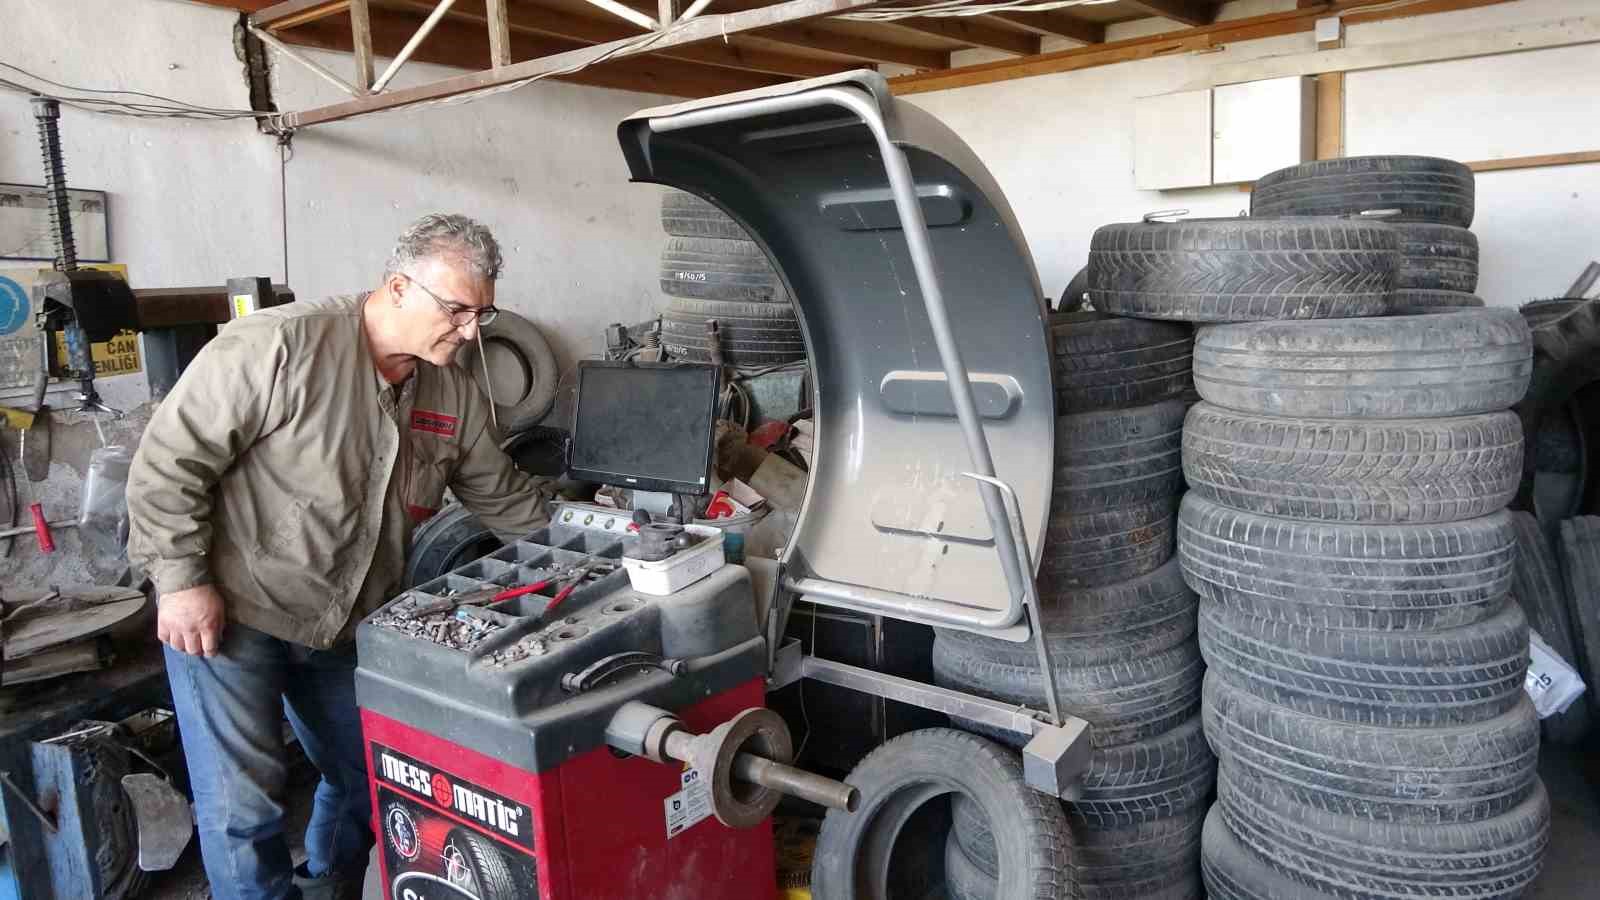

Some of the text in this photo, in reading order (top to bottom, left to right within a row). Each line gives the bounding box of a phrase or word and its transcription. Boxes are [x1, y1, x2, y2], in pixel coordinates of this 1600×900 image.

[106, 340, 135, 355] CAN
[95, 353, 138, 374] ENLİĞİ
[381, 752, 432, 797] MESS
